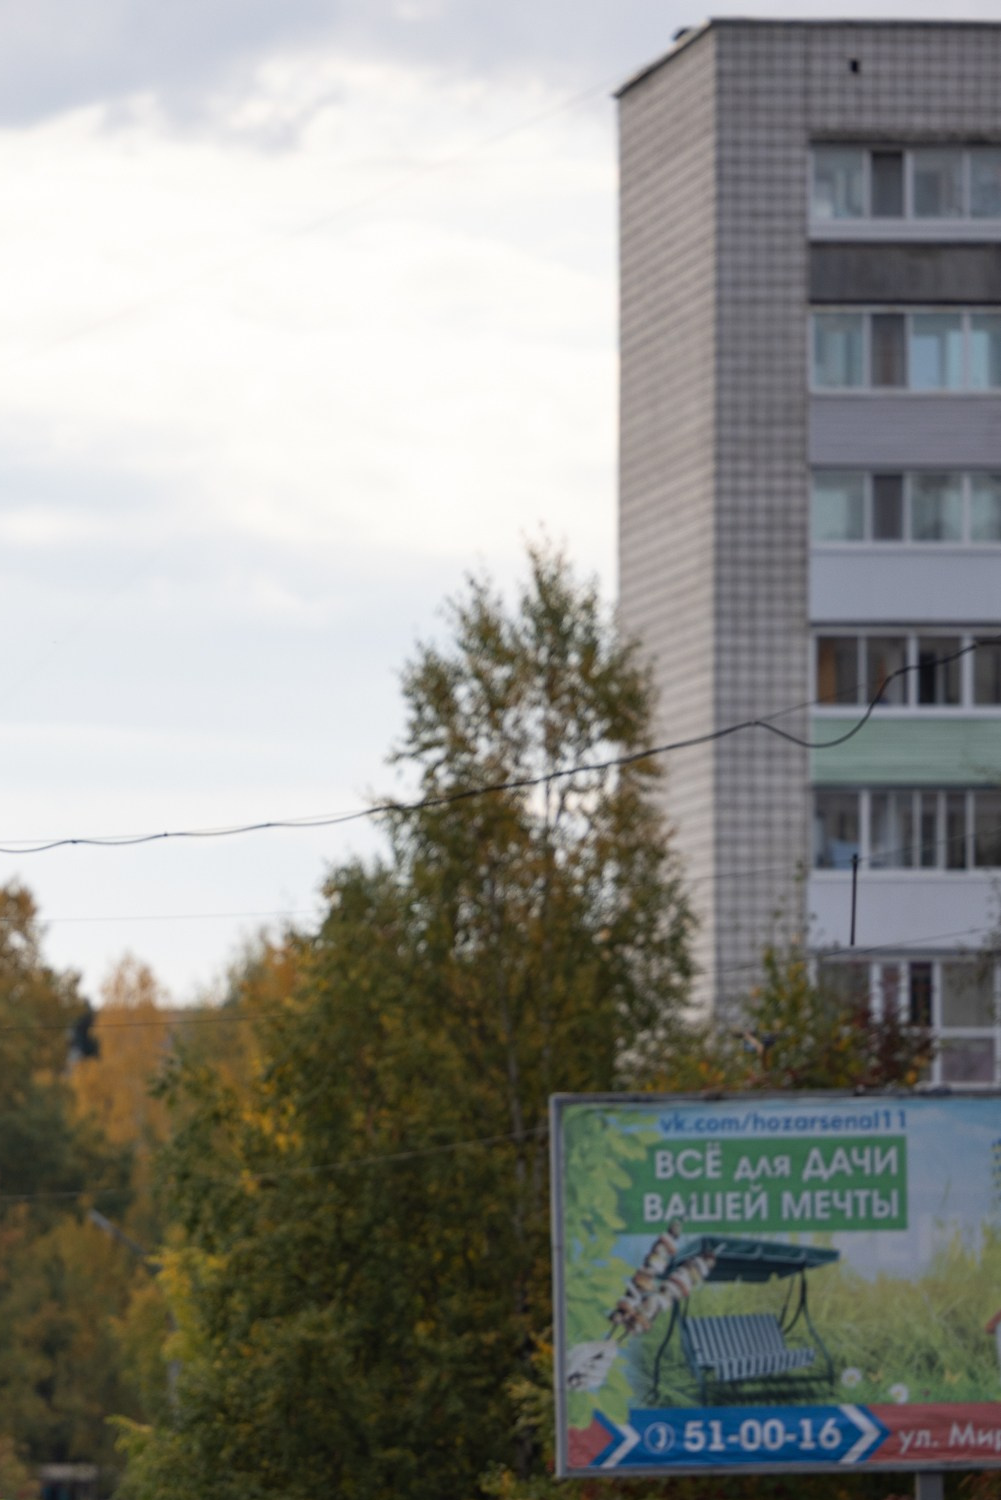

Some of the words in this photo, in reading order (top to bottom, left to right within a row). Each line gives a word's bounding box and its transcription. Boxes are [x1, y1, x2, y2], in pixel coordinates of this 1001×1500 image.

[660, 1110, 906, 1133] vk.com/hozarsenal11
[654, 1142, 722, 1180] ВСЁ
[734, 1155, 791, 1182] для
[802, 1146, 898, 1182] ДАЧИ
[643, 1184, 768, 1223] ВАШЕЙ
[781, 1188, 899, 1220] МЕЧТЫ
[683, 1418, 842, 1453] 51-00-16
[898, 1429, 940, 1455] ул.
